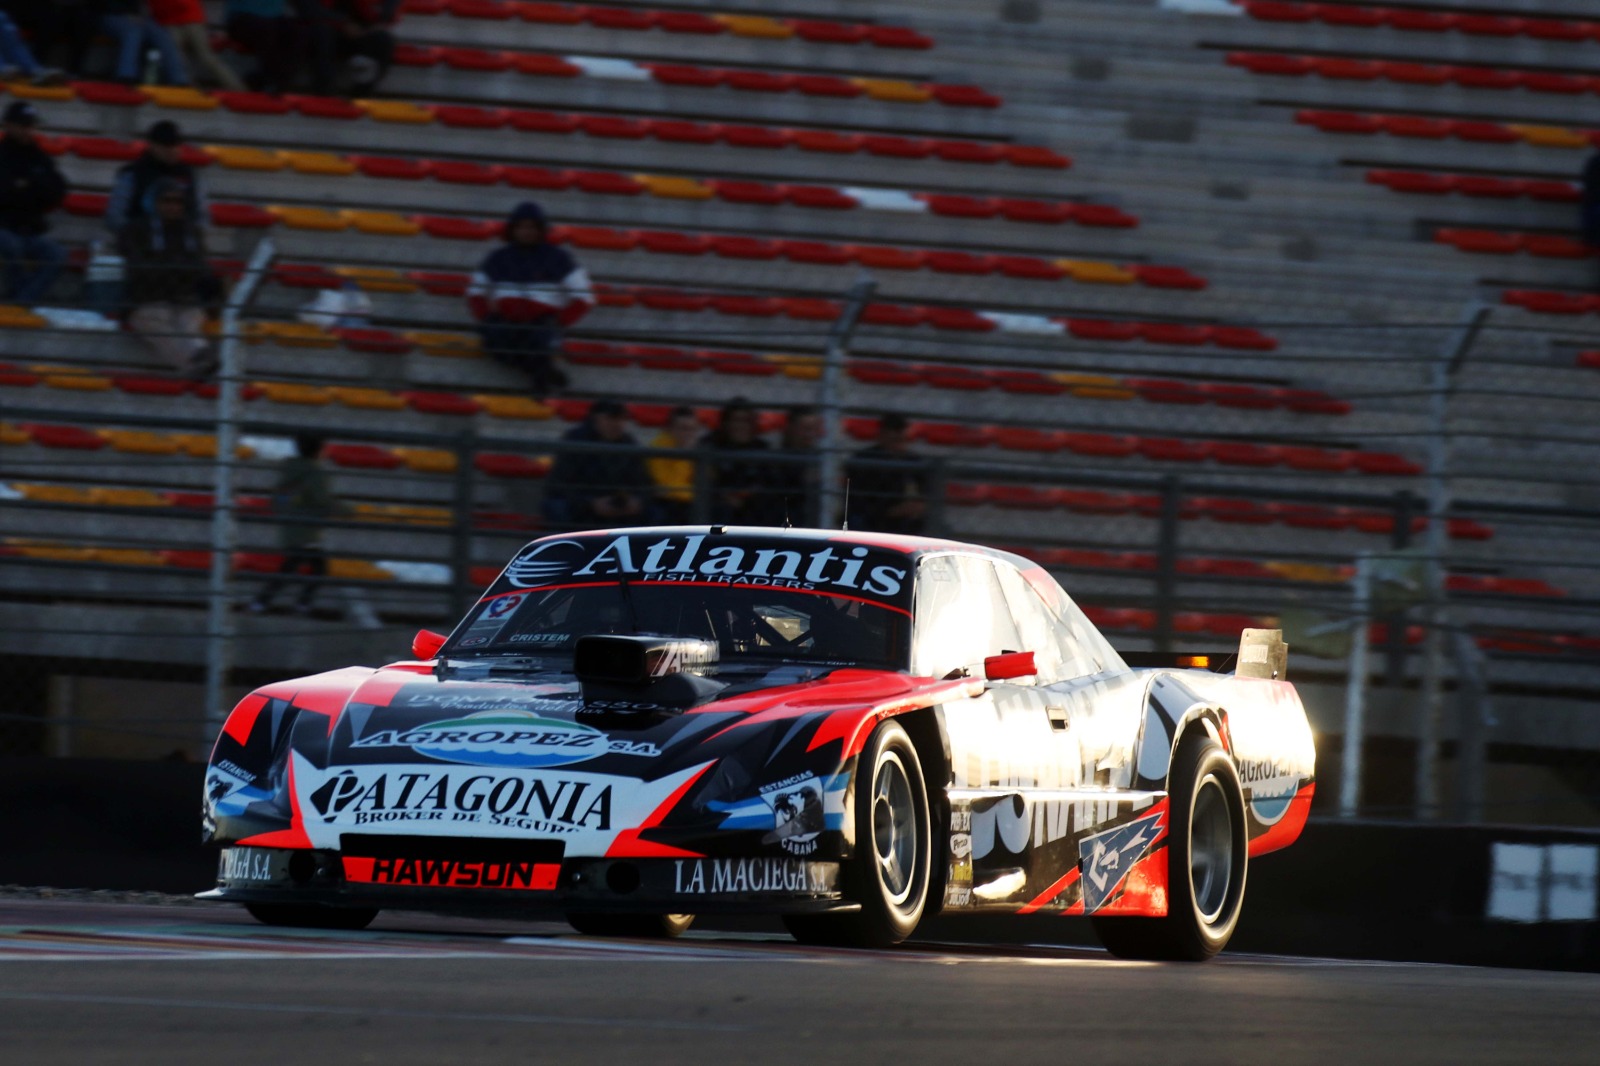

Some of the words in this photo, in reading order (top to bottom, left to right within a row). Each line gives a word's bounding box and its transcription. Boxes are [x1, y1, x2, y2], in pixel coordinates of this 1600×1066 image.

[571, 534, 907, 596] Atlantis
[643, 573, 697, 582] FISH
[703, 574, 817, 591] TRADERS
[509, 633, 571, 643] CRISTEM
[355, 729, 603, 748] AGROPEZ
[758, 770, 815, 793] ESTANCIAS
[354, 810, 444, 826] BROKER
[452, 811, 482, 823] DE
[371, 858, 536, 888] HAWSON
[674, 859, 707, 894] LA
[711, 857, 808, 893] MACIEGA
